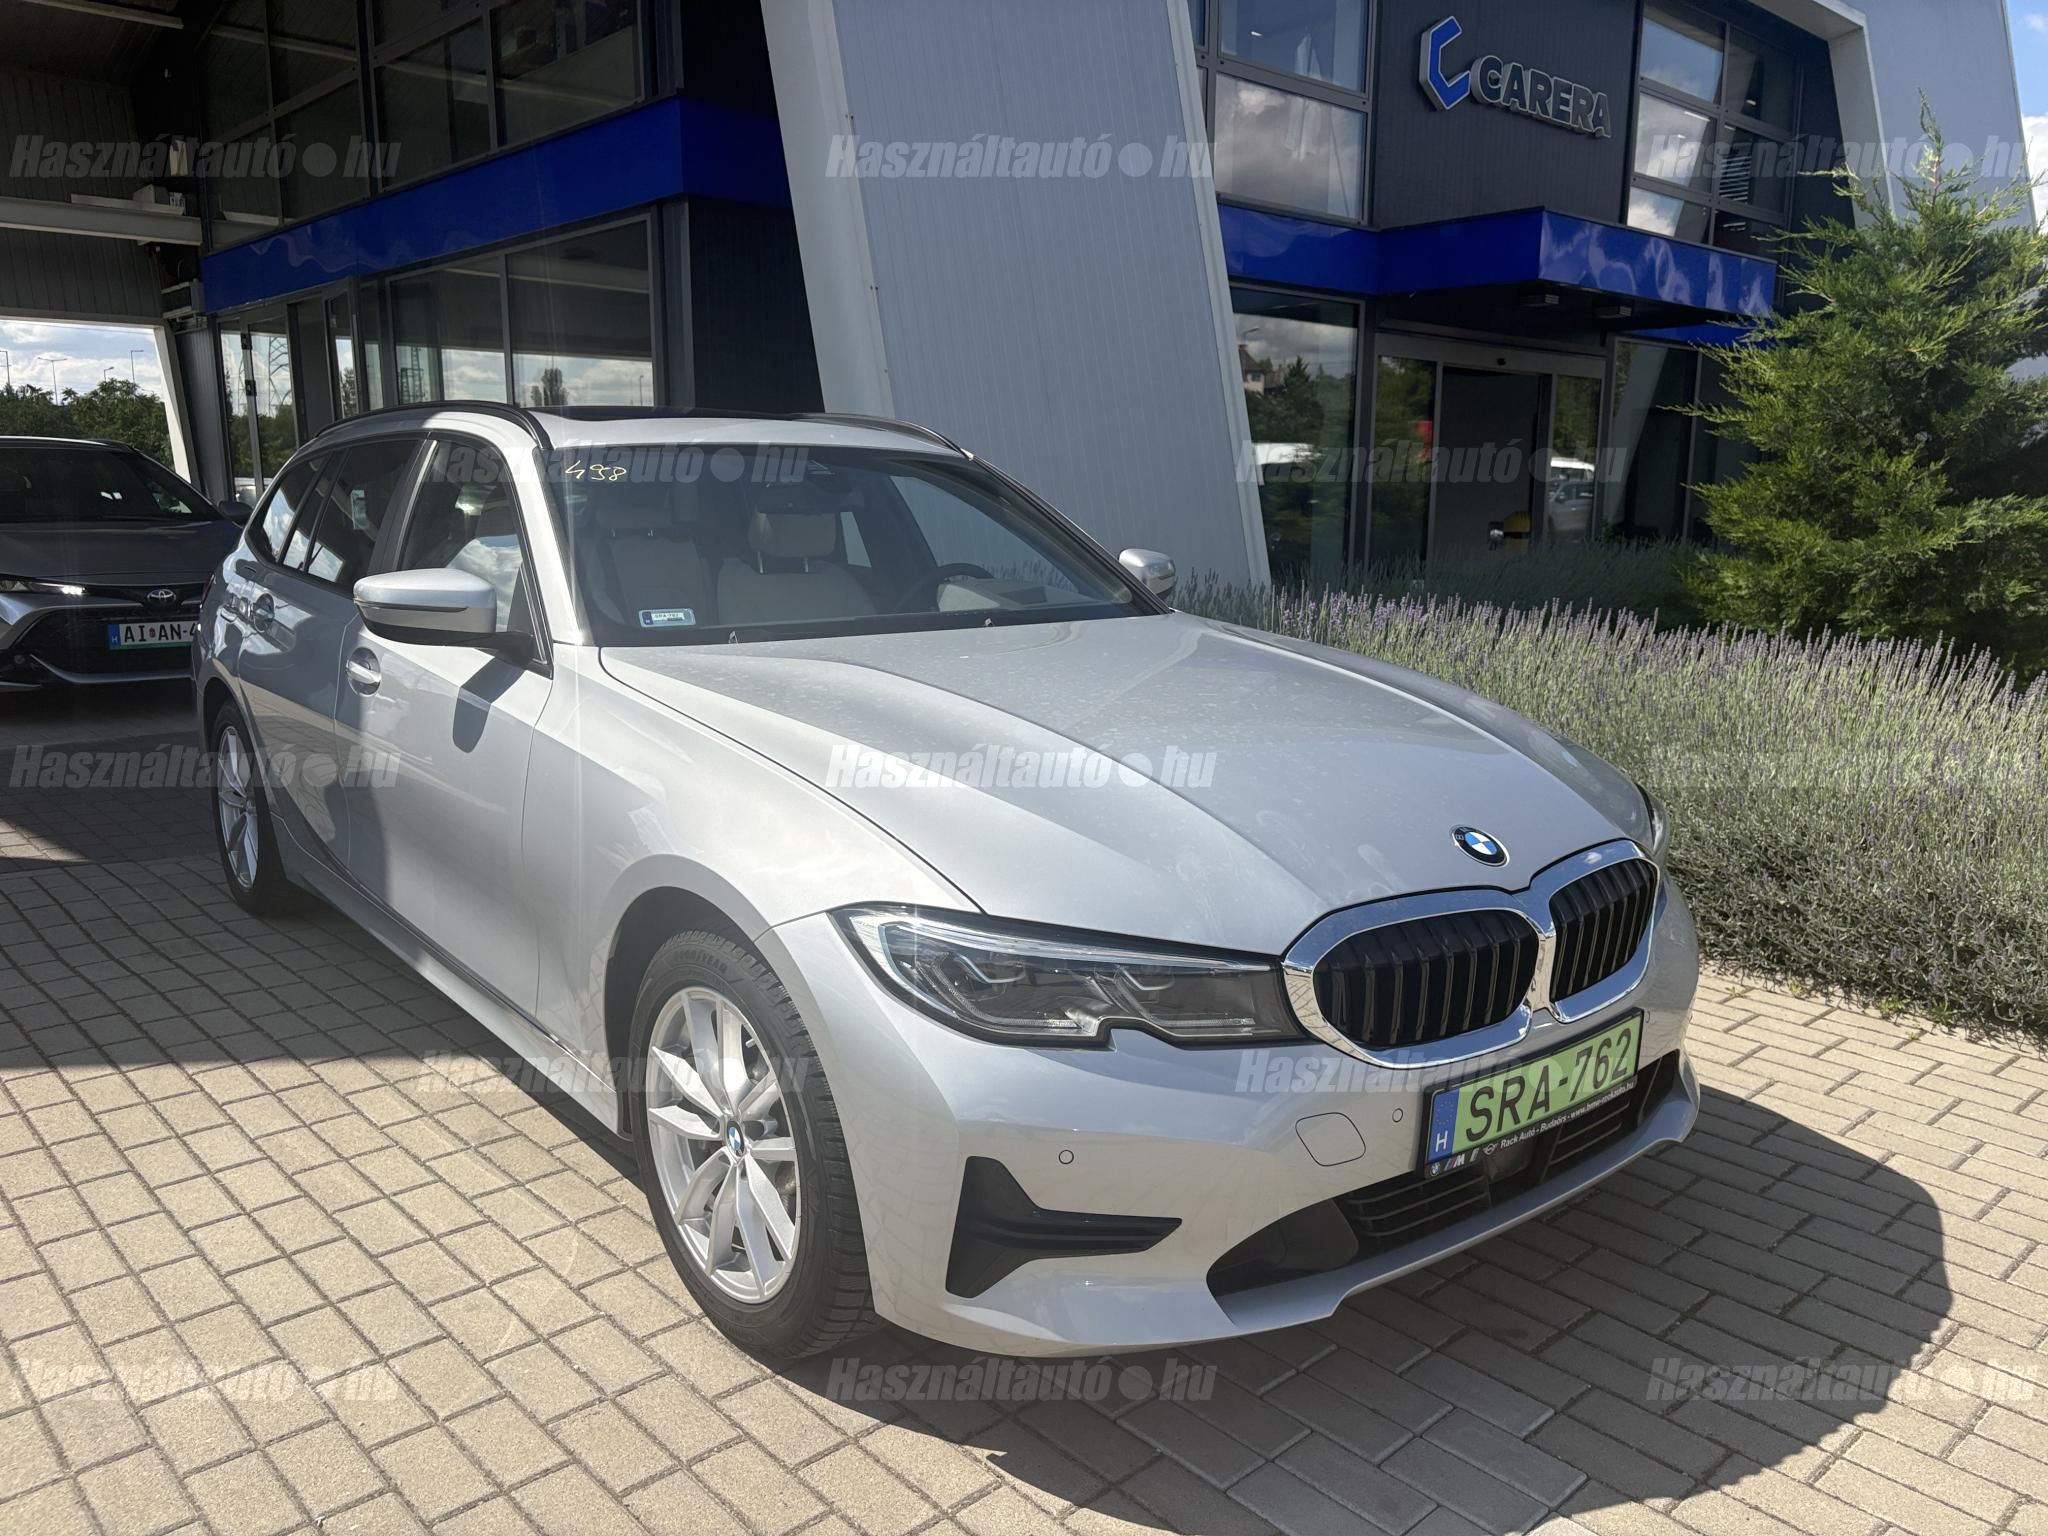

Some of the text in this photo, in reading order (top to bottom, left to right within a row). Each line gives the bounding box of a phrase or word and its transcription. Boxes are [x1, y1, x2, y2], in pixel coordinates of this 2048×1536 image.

[1473, 55, 1611, 138] CARERA
[124, 625, 147, 642] AI
[1465, 1028, 1632, 1142] SRA-762
[1435, 1130, 1449, 1153] H
[1500, 1134, 1518, 1149] Rack
[1519, 1126, 1536, 1141] Autó
